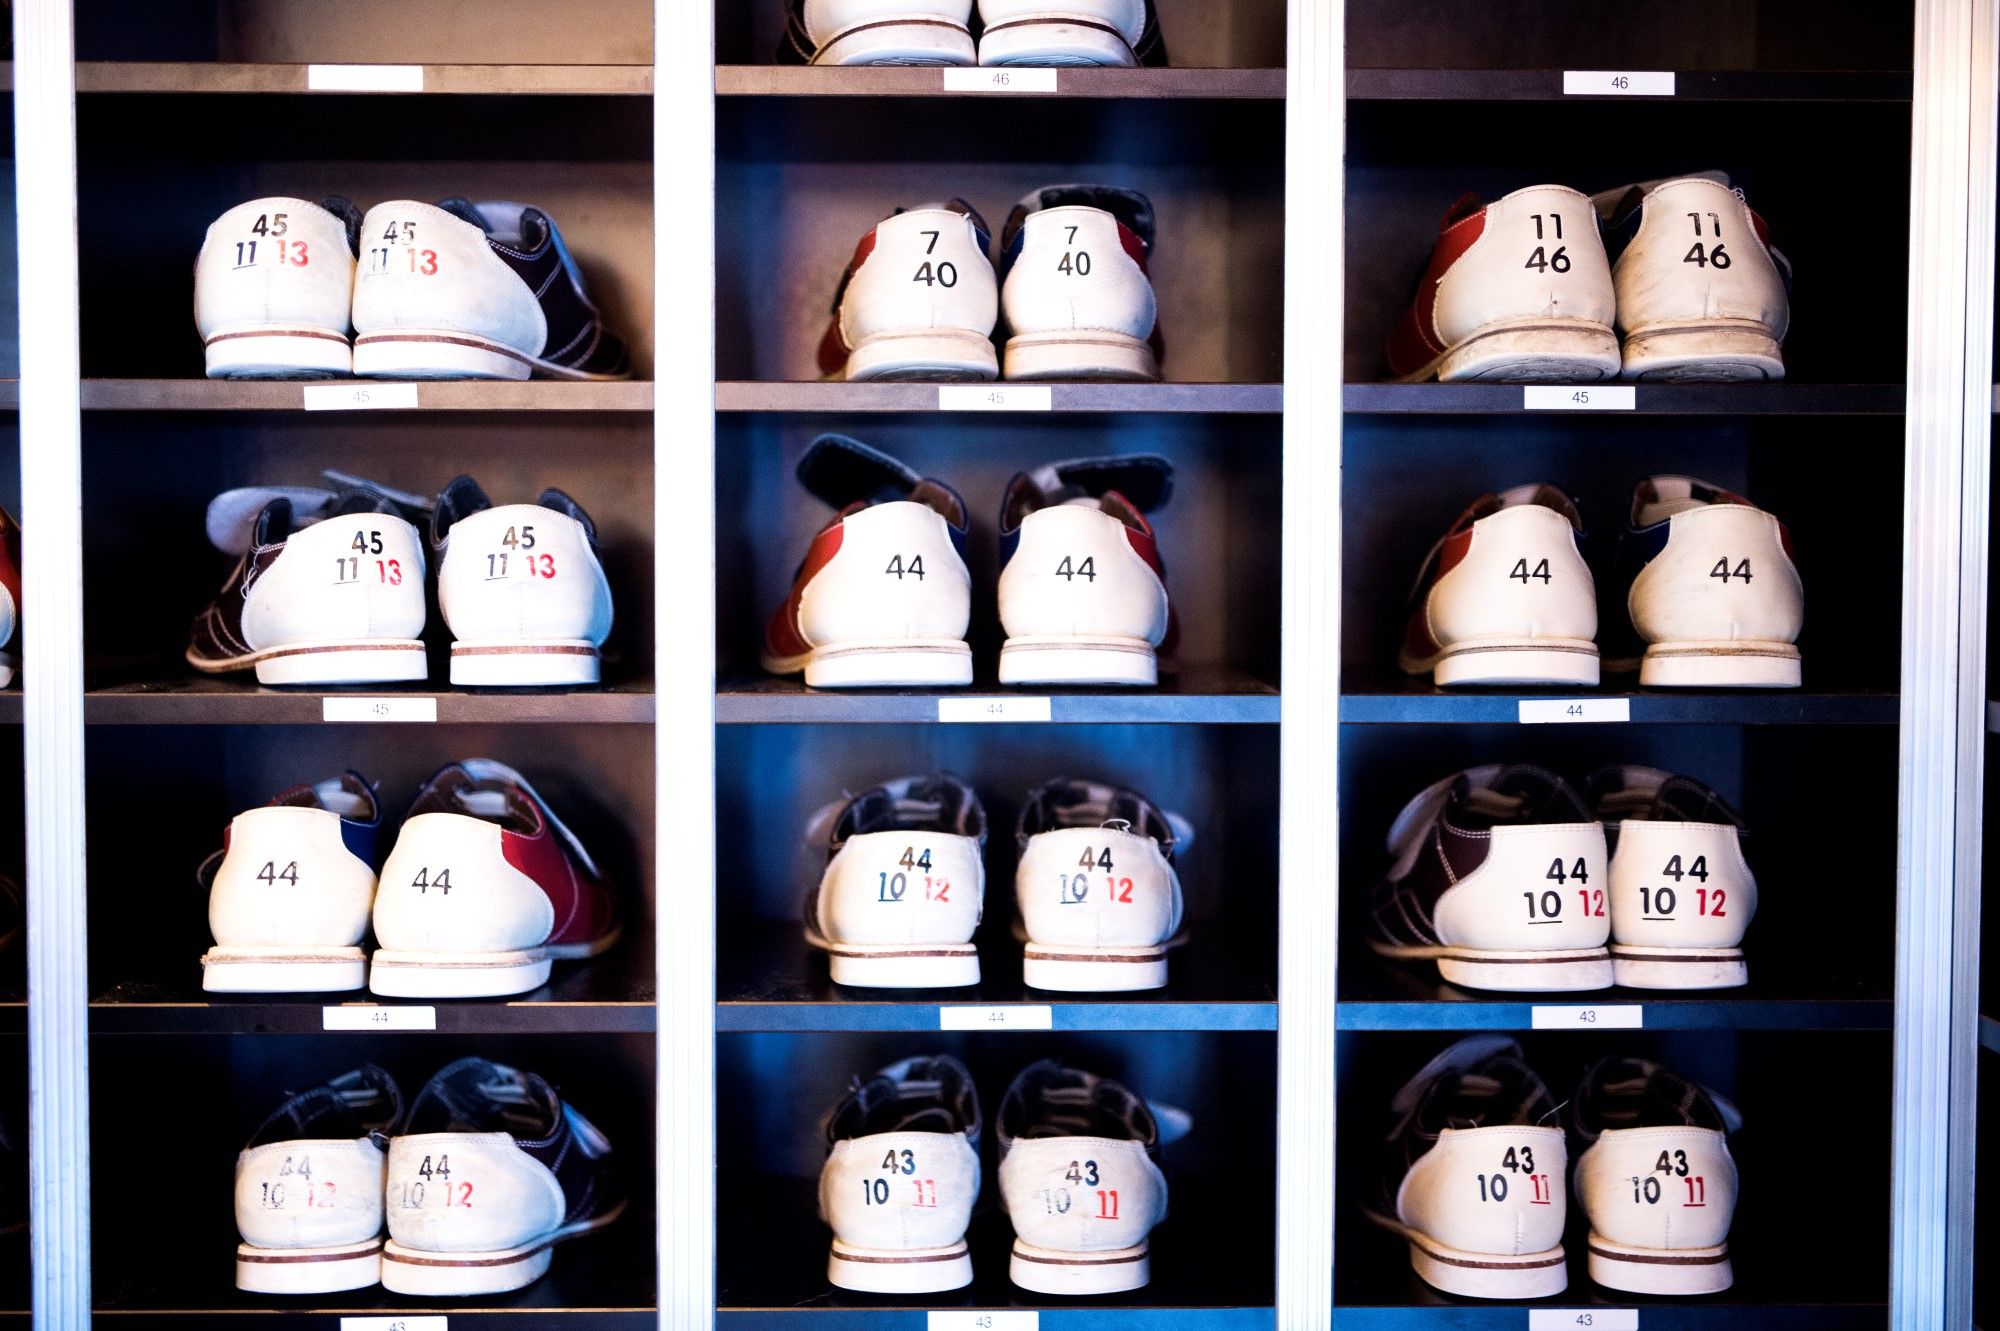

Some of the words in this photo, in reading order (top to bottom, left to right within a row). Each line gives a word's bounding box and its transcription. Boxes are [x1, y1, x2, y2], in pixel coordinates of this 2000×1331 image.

[992, 73, 1010, 85] 46
[1611, 77, 1628, 89] 46
[251, 214, 289, 236] 45
[382, 221, 416, 244] 45
[1064, 226, 1077, 245] 7
[1531, 214, 1562, 239] 11
[1687, 213, 1721, 237] 11
[235, 242, 258, 266] 11
[276, 241, 309, 267] 13
[920, 231, 940, 255] 7
[1683, 242, 1730, 268] 46
[370, 249, 389, 273] 11
[406, 250, 438, 274] 13
[1057, 253, 1091, 276] 40
[1524, 246, 1571, 273] 46
[913, 262, 958, 288] 40
[1572, 391, 1589, 403] 45
[352, 531, 384, 554] 45
[502, 526, 535, 549] 45
[336, 558, 358, 580] 11
[376, 559, 402, 585] 13
[487, 554, 507, 577] 11
[525, 554, 555, 578] 13
[885, 555, 925, 580] 44
[1055, 556, 1096, 582] 44
[1509, 558, 1551, 583] 44
[1709, 557, 1752, 583] 44
[987, 704, 1003, 715] 44
[1566, 705, 1583, 716] 44
[899, 847, 932, 871] 44
[1078, 847, 1113, 871] 44
[1545, 858, 1588, 884] 44
[1662, 856, 1708, 882] 44
[257, 861, 299, 886] 44
[412, 868, 452, 894] 44
[878, 873, 905, 898] 10
[924, 877, 950, 901] 12
[1060, 874, 1088, 901] 10
[1106, 877, 1132, 902] 12
[1524, 892, 1561, 917] 10
[1579, 890, 1605, 916] 12
[1640, 887, 1676, 914] 10
[1696, 889, 1726, 916] 12
[372, 1013, 388, 1023] 44
[988, 1012, 1005, 1023] 44
[1579, 1011, 1596, 1022] 43
[279, 1156, 313, 1180] 44
[419, 1155, 451, 1181] 44
[882, 1150, 916, 1174] 43
[1502, 1146, 1534, 1173] 43
[1655, 1150, 1689, 1176] 43
[1065, 1161, 1099, 1185] 43
[261, 1183, 286, 1206] 10
[305, 1182, 336, 1207] 12
[401, 1182, 425, 1206] 10
[444, 1183, 473, 1207] 12
[863, 1179, 889, 1205] 10
[913, 1180, 935, 1203] 11
[1478, 1174, 1508, 1201] 10
[1530, 1174, 1549, 1200] 11
[1632, 1176, 1660, 1203] 10
[1683, 1176, 1705, 1203] 11
[1042, 1188, 1071, 1214] 10
[1097, 1191, 1118, 1217] 11
[976, 1317, 992, 1329] 43
[1576, 1314, 1593, 1325] 43
